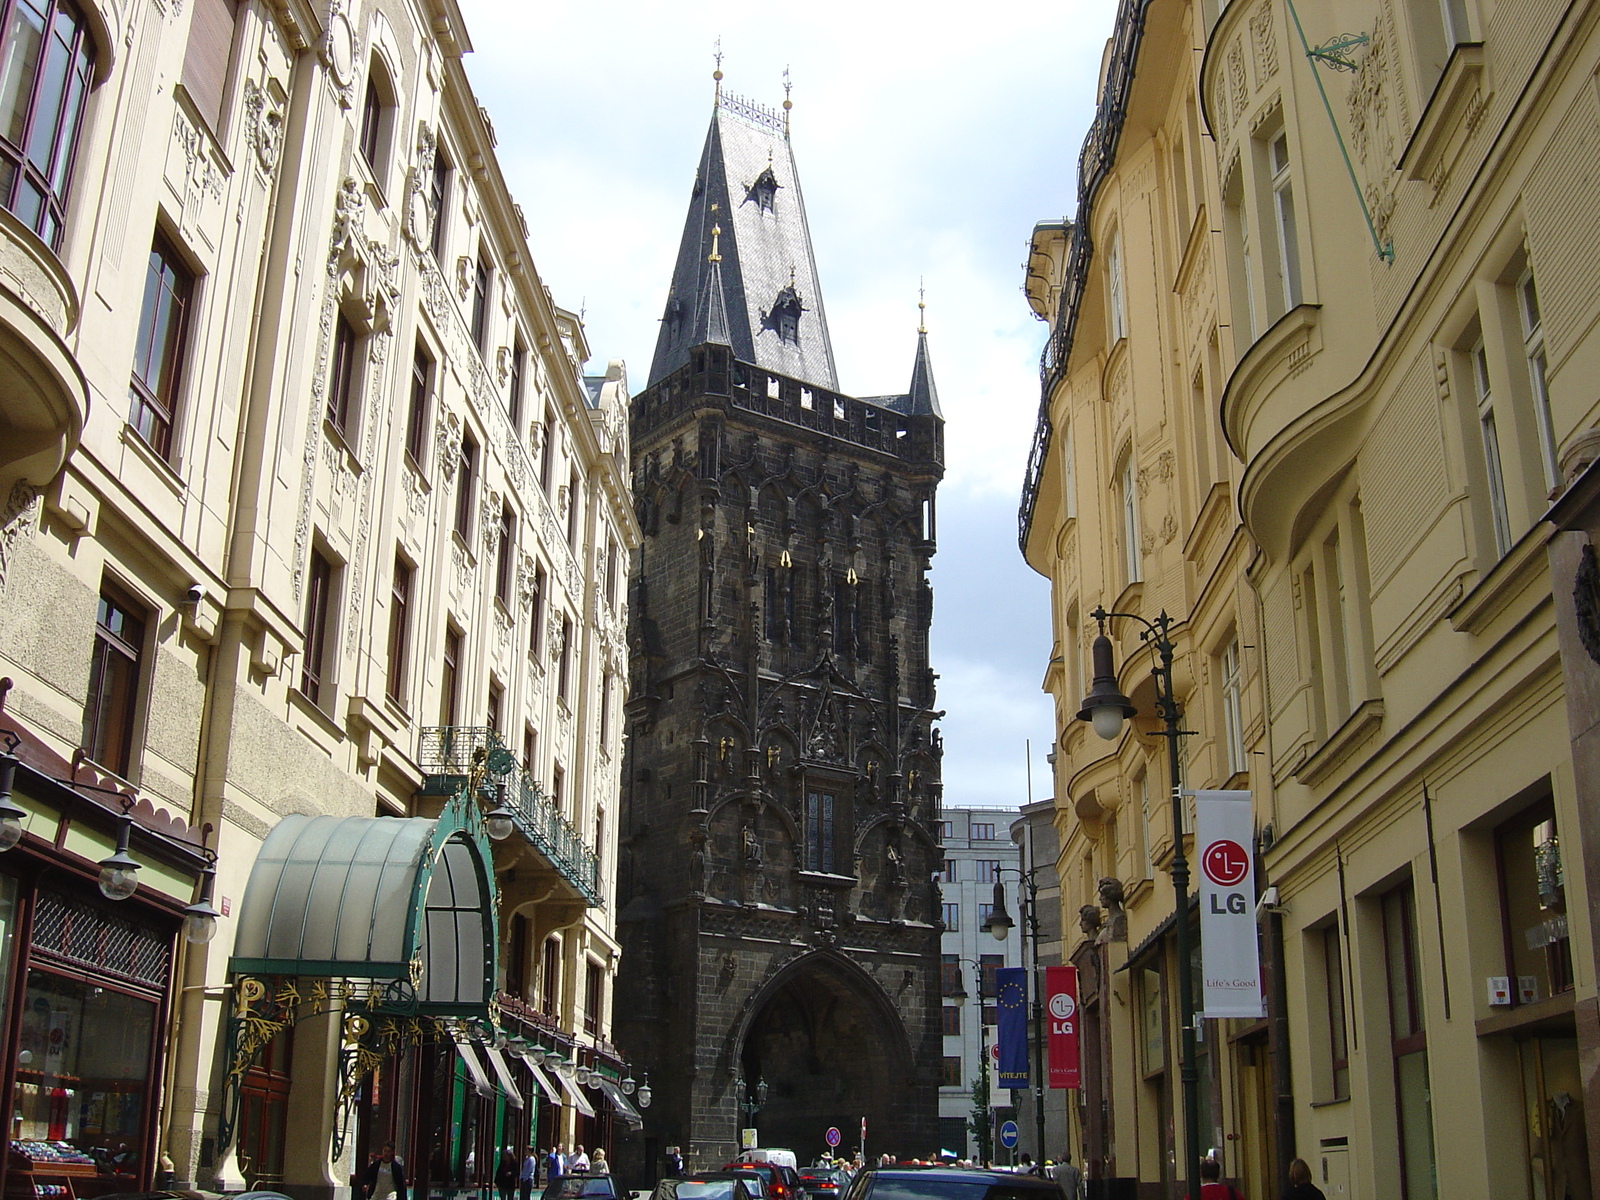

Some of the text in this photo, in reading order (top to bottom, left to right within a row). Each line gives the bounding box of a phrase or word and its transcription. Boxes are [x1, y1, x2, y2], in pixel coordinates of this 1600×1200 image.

[1210, 893, 1246, 914] LG
[1206, 979, 1256, 987] Life's Good
[1053, 1022, 1073, 1034] LG
[1000, 1071, 1027, 1079] VÍTEJTE
